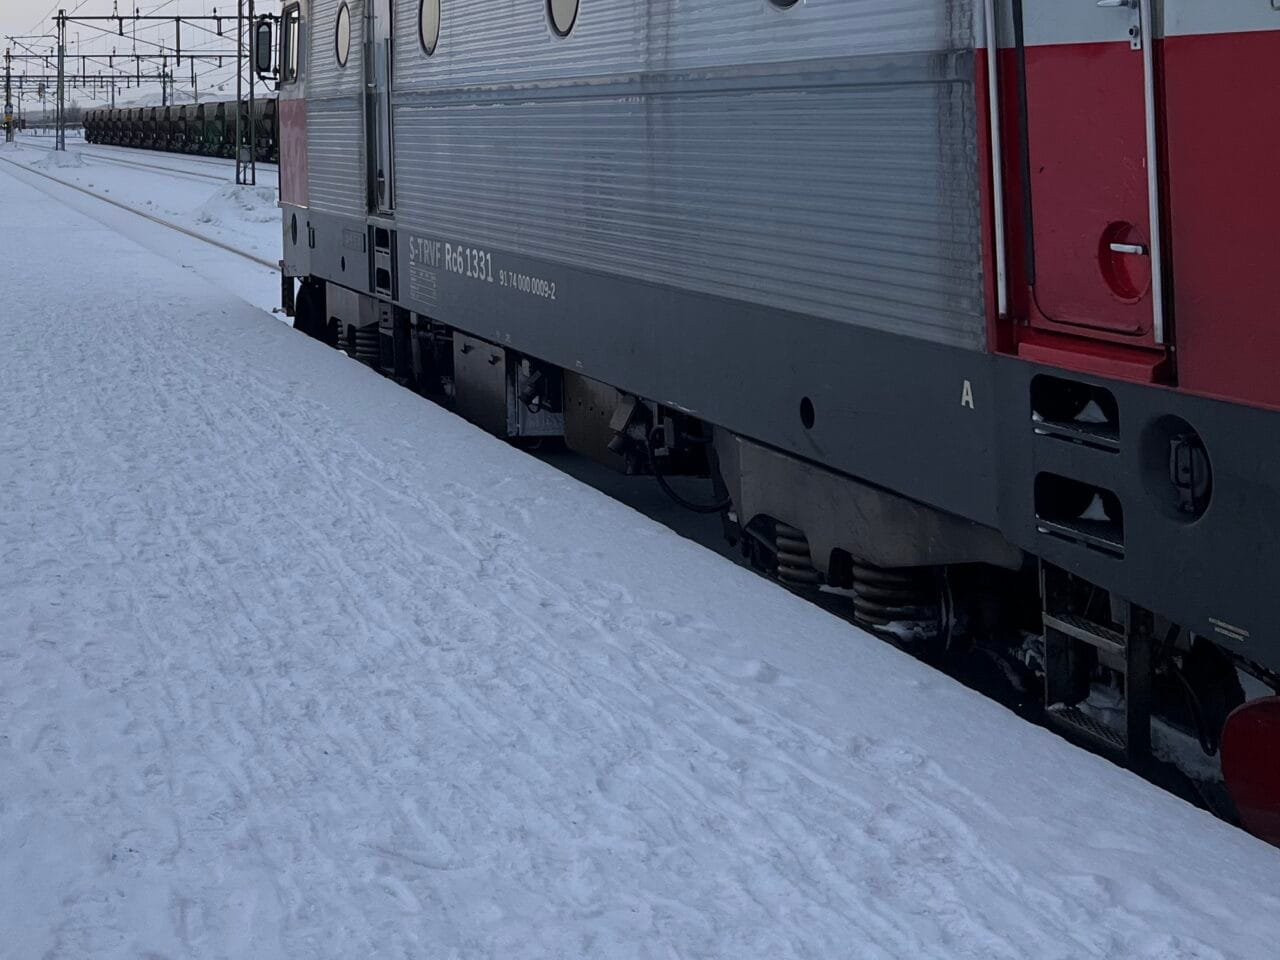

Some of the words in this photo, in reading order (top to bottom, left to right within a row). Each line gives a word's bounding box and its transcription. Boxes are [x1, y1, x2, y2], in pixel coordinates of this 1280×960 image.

[409, 236, 440, 267] S-TRVF
[445, 242, 464, 274] Rc6
[465, 247, 494, 283] 1331
[500, 269, 508, 286] 91
[509, 271, 517, 288] 74
[518, 274, 530, 293] 000
[961, 379, 974, 409] A
